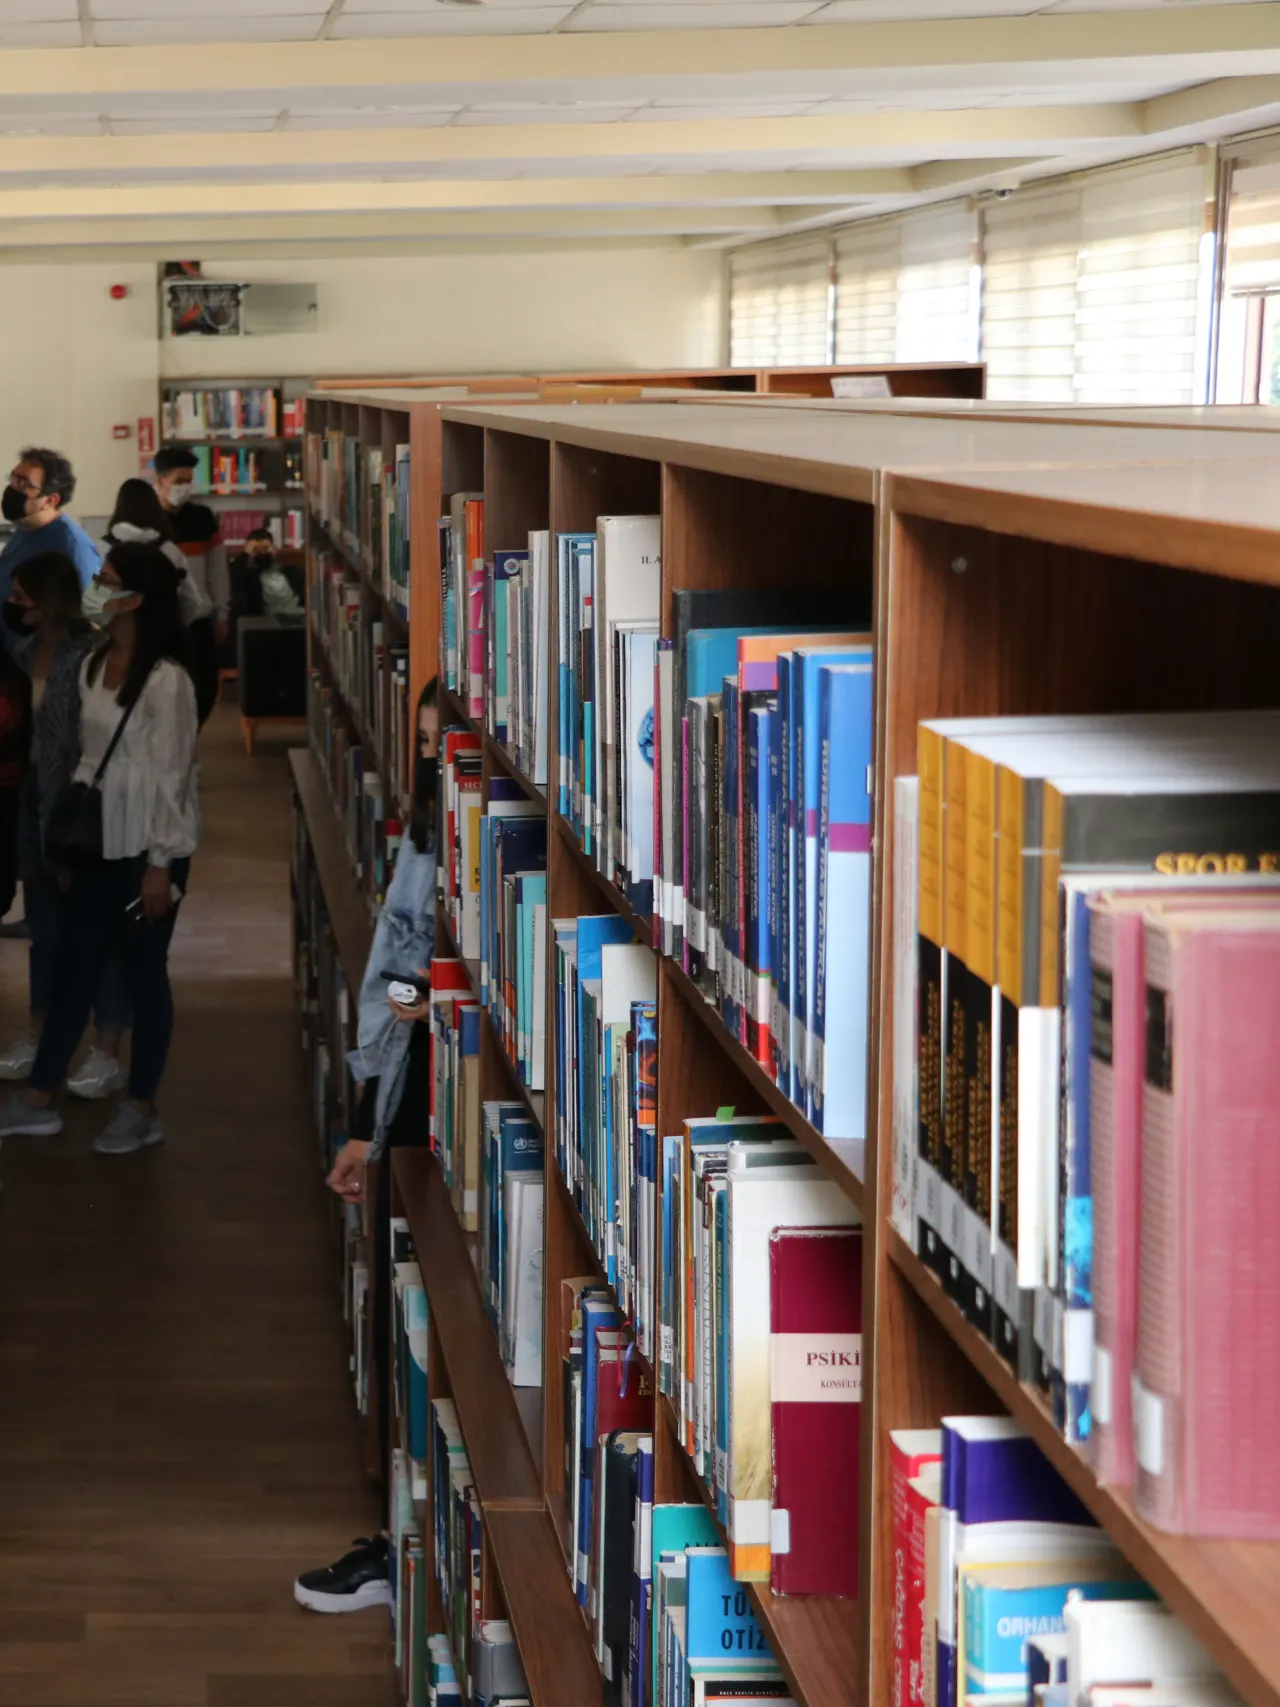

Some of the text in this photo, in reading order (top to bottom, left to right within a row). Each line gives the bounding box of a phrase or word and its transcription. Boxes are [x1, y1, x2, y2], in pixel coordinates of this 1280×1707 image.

[816, 739, 829, 1016] RUHSAL HASTALIKLAR
[721, 1591, 754, 1616] TÜ
